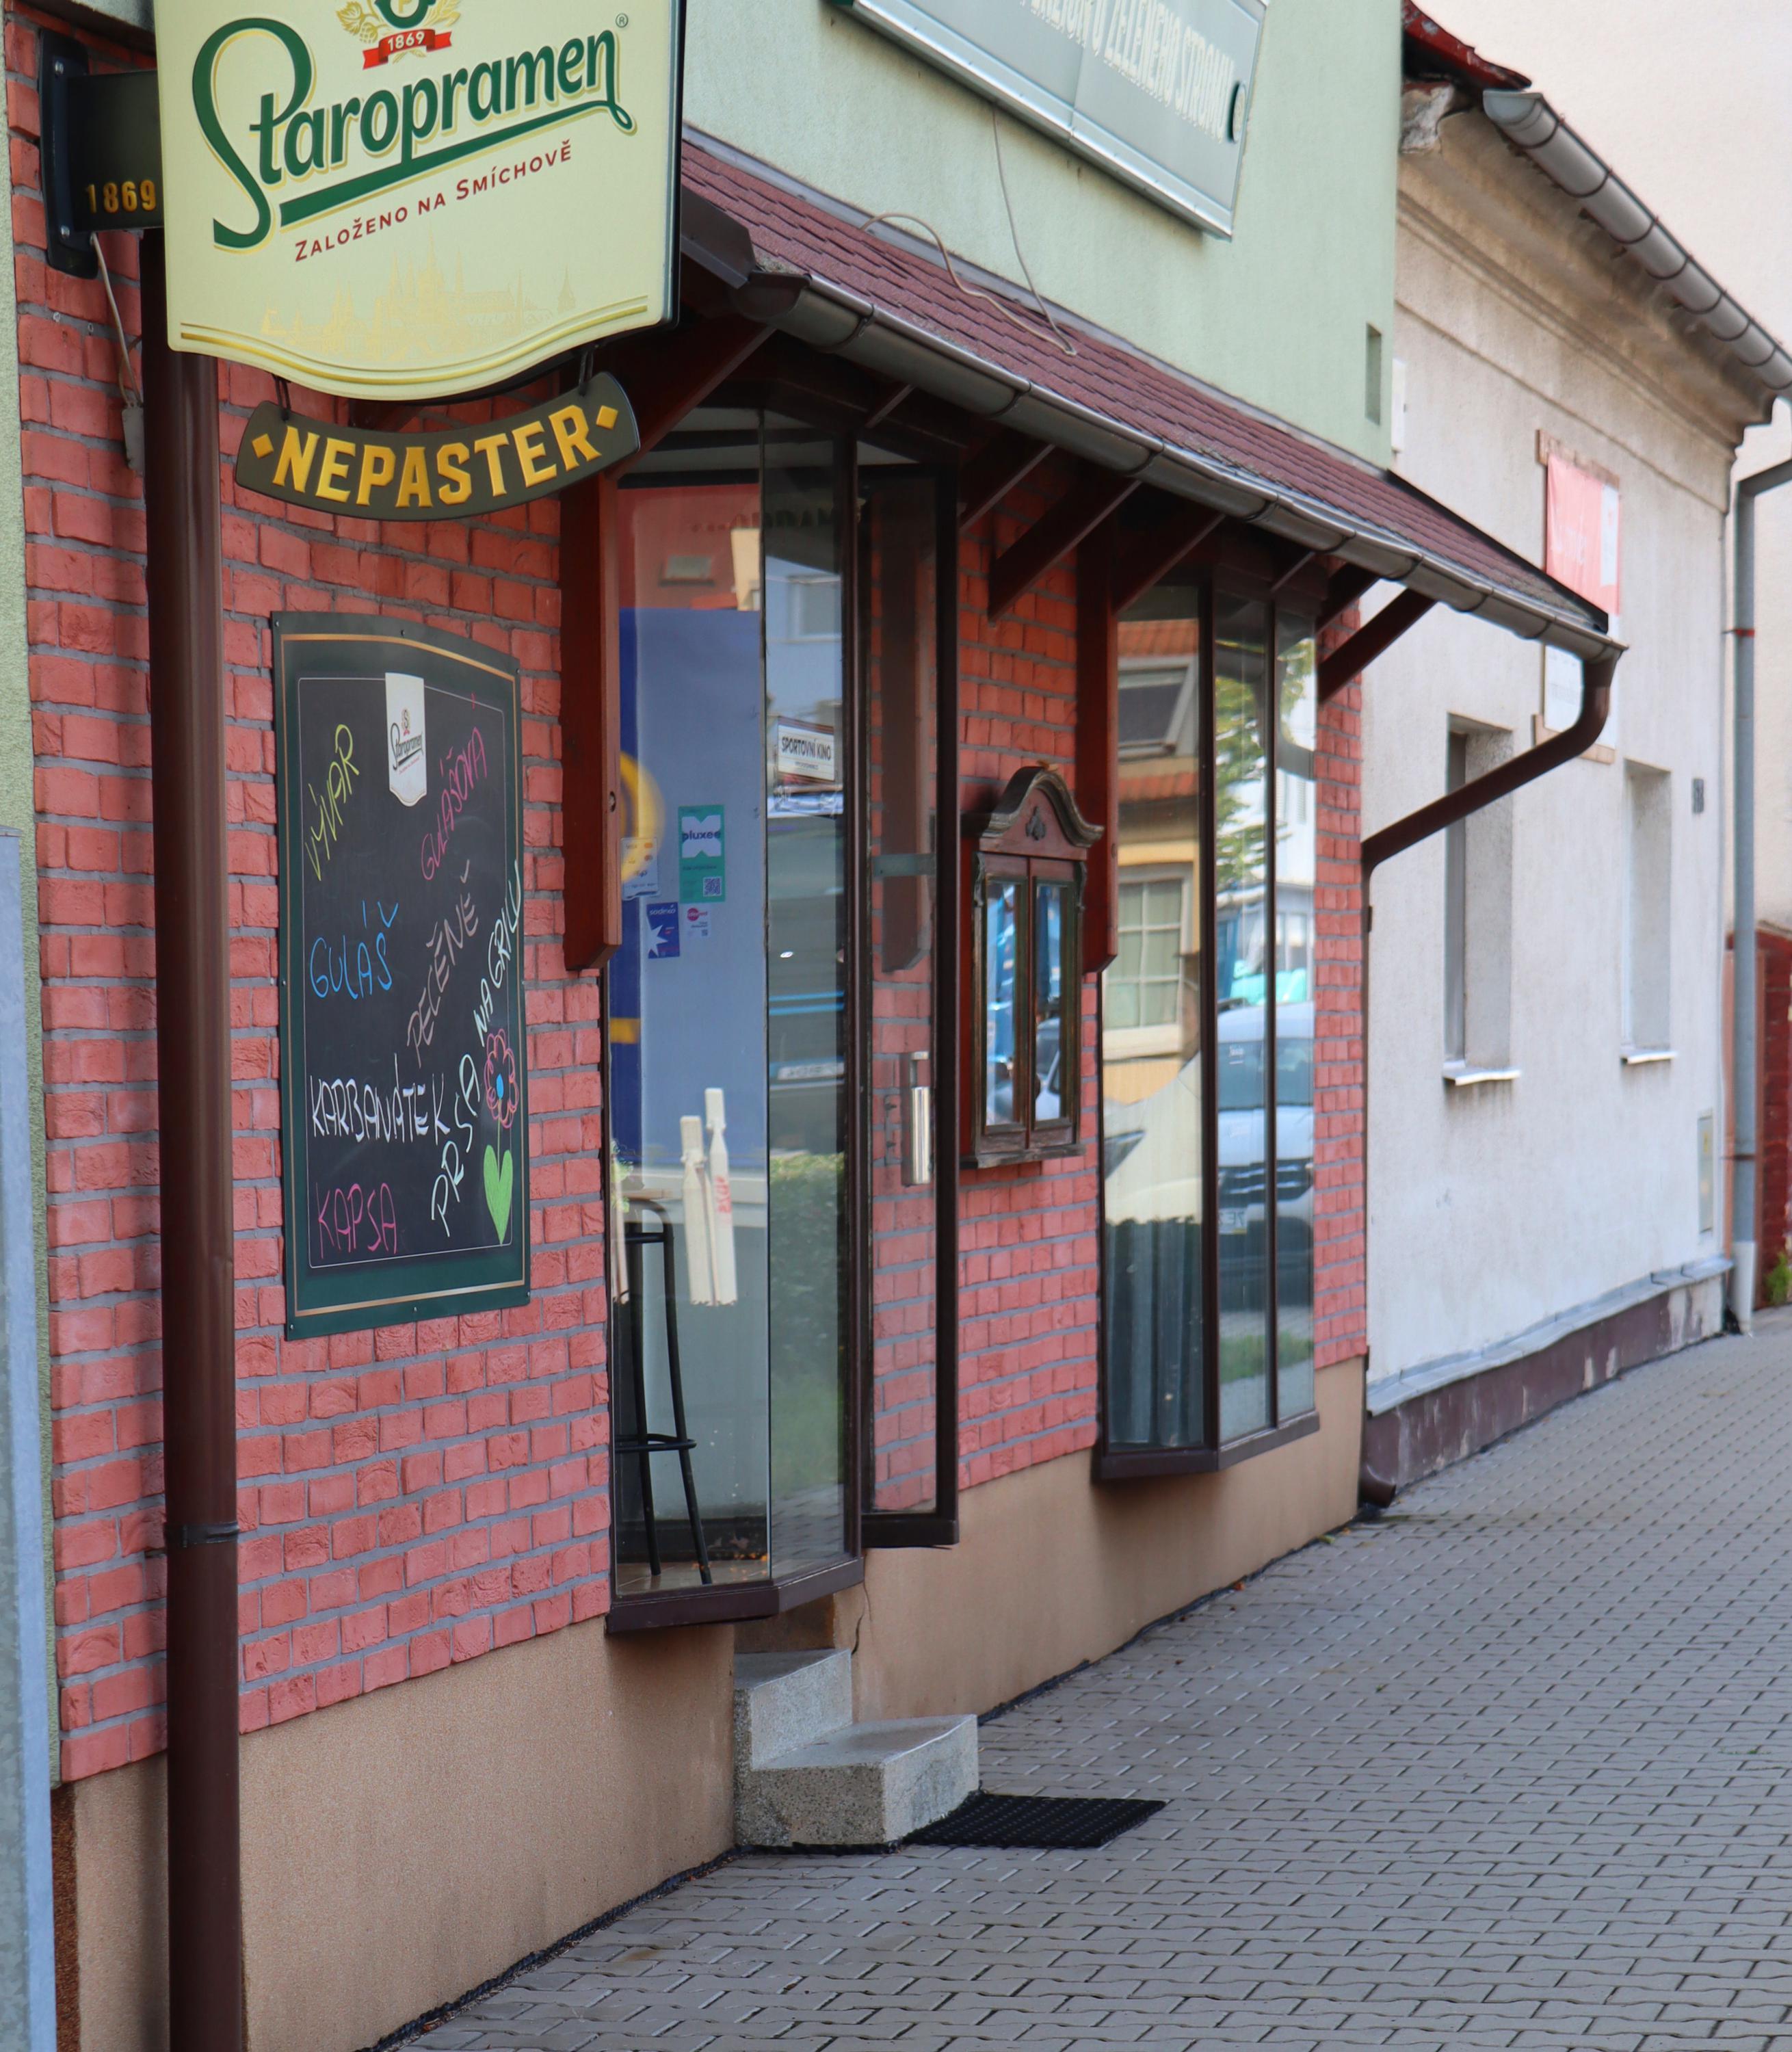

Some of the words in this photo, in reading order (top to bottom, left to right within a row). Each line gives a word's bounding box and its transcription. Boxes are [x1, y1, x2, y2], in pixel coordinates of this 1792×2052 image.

[387, 31, 425, 51] 1869
[192, 17, 635, 248] Staropramen
[85, 179, 157, 213] 1869
[295, 206, 409, 262] ZALOŽENO
[417, 192, 446, 215] NA
[272, 404, 602, 508] NEPASTER
[817, 744, 832, 761] KINO
[305, 724, 360, 881] VÝVAR
[681, 830, 721, 842] pluxee
[310, 899, 399, 1000] GULÁŠ
[309, 1052, 451, 1146] KARBANÁTEK
[432, 1053, 481, 1237] PRSA
[473, 977, 493, 1047] NA
[315, 1182, 398, 1259] KAPSA
